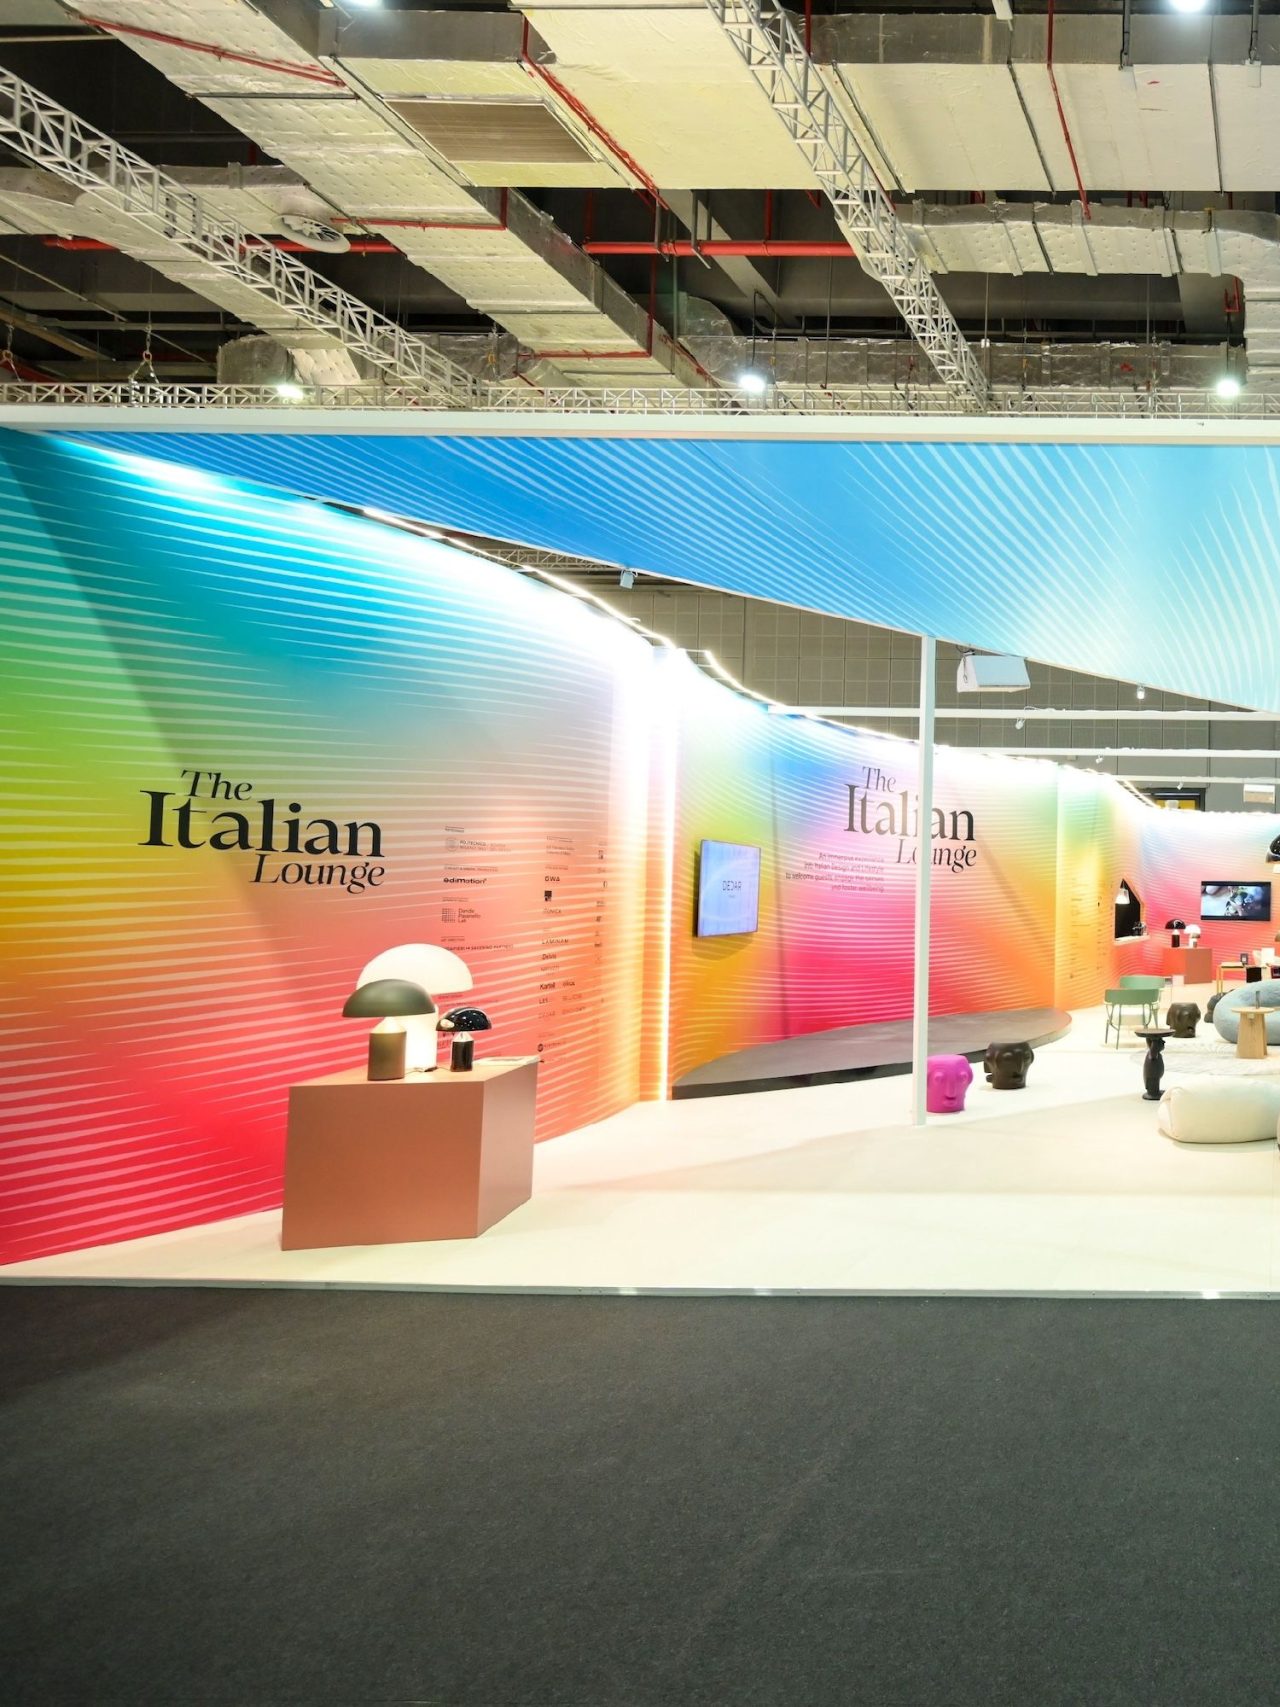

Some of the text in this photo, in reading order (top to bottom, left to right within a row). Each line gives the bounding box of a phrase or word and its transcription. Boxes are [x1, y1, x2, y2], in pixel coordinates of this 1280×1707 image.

[181, 769, 253, 801] The
[862, 766, 896, 792] The
[137, 789, 385, 858] Italian
[249, 853, 385, 895] Lounge
